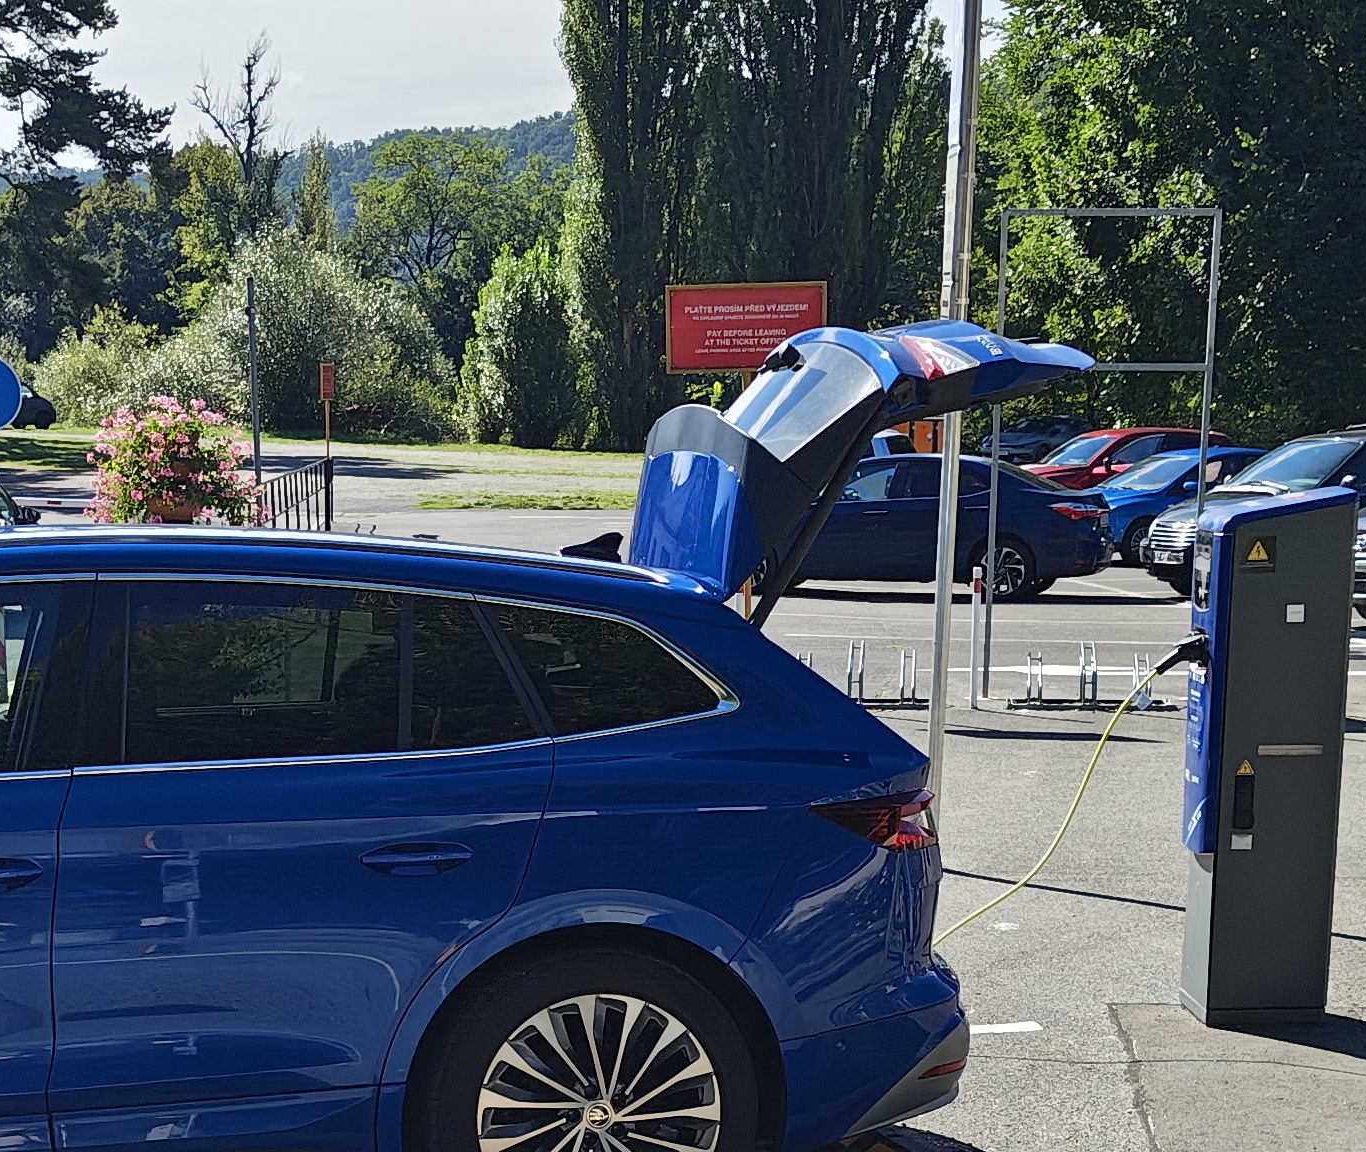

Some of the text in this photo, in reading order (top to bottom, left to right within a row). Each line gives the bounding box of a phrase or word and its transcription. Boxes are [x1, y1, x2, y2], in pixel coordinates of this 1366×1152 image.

[714, 304, 744, 314] PROSÍM
[744, 303, 766, 312] PŘED
[706, 328, 787, 337] PAY BEFORE LEAVING
[704, 338, 715, 346] AT
[716, 338, 731, 346] THE
[732, 337, 759, 346] TICKET
